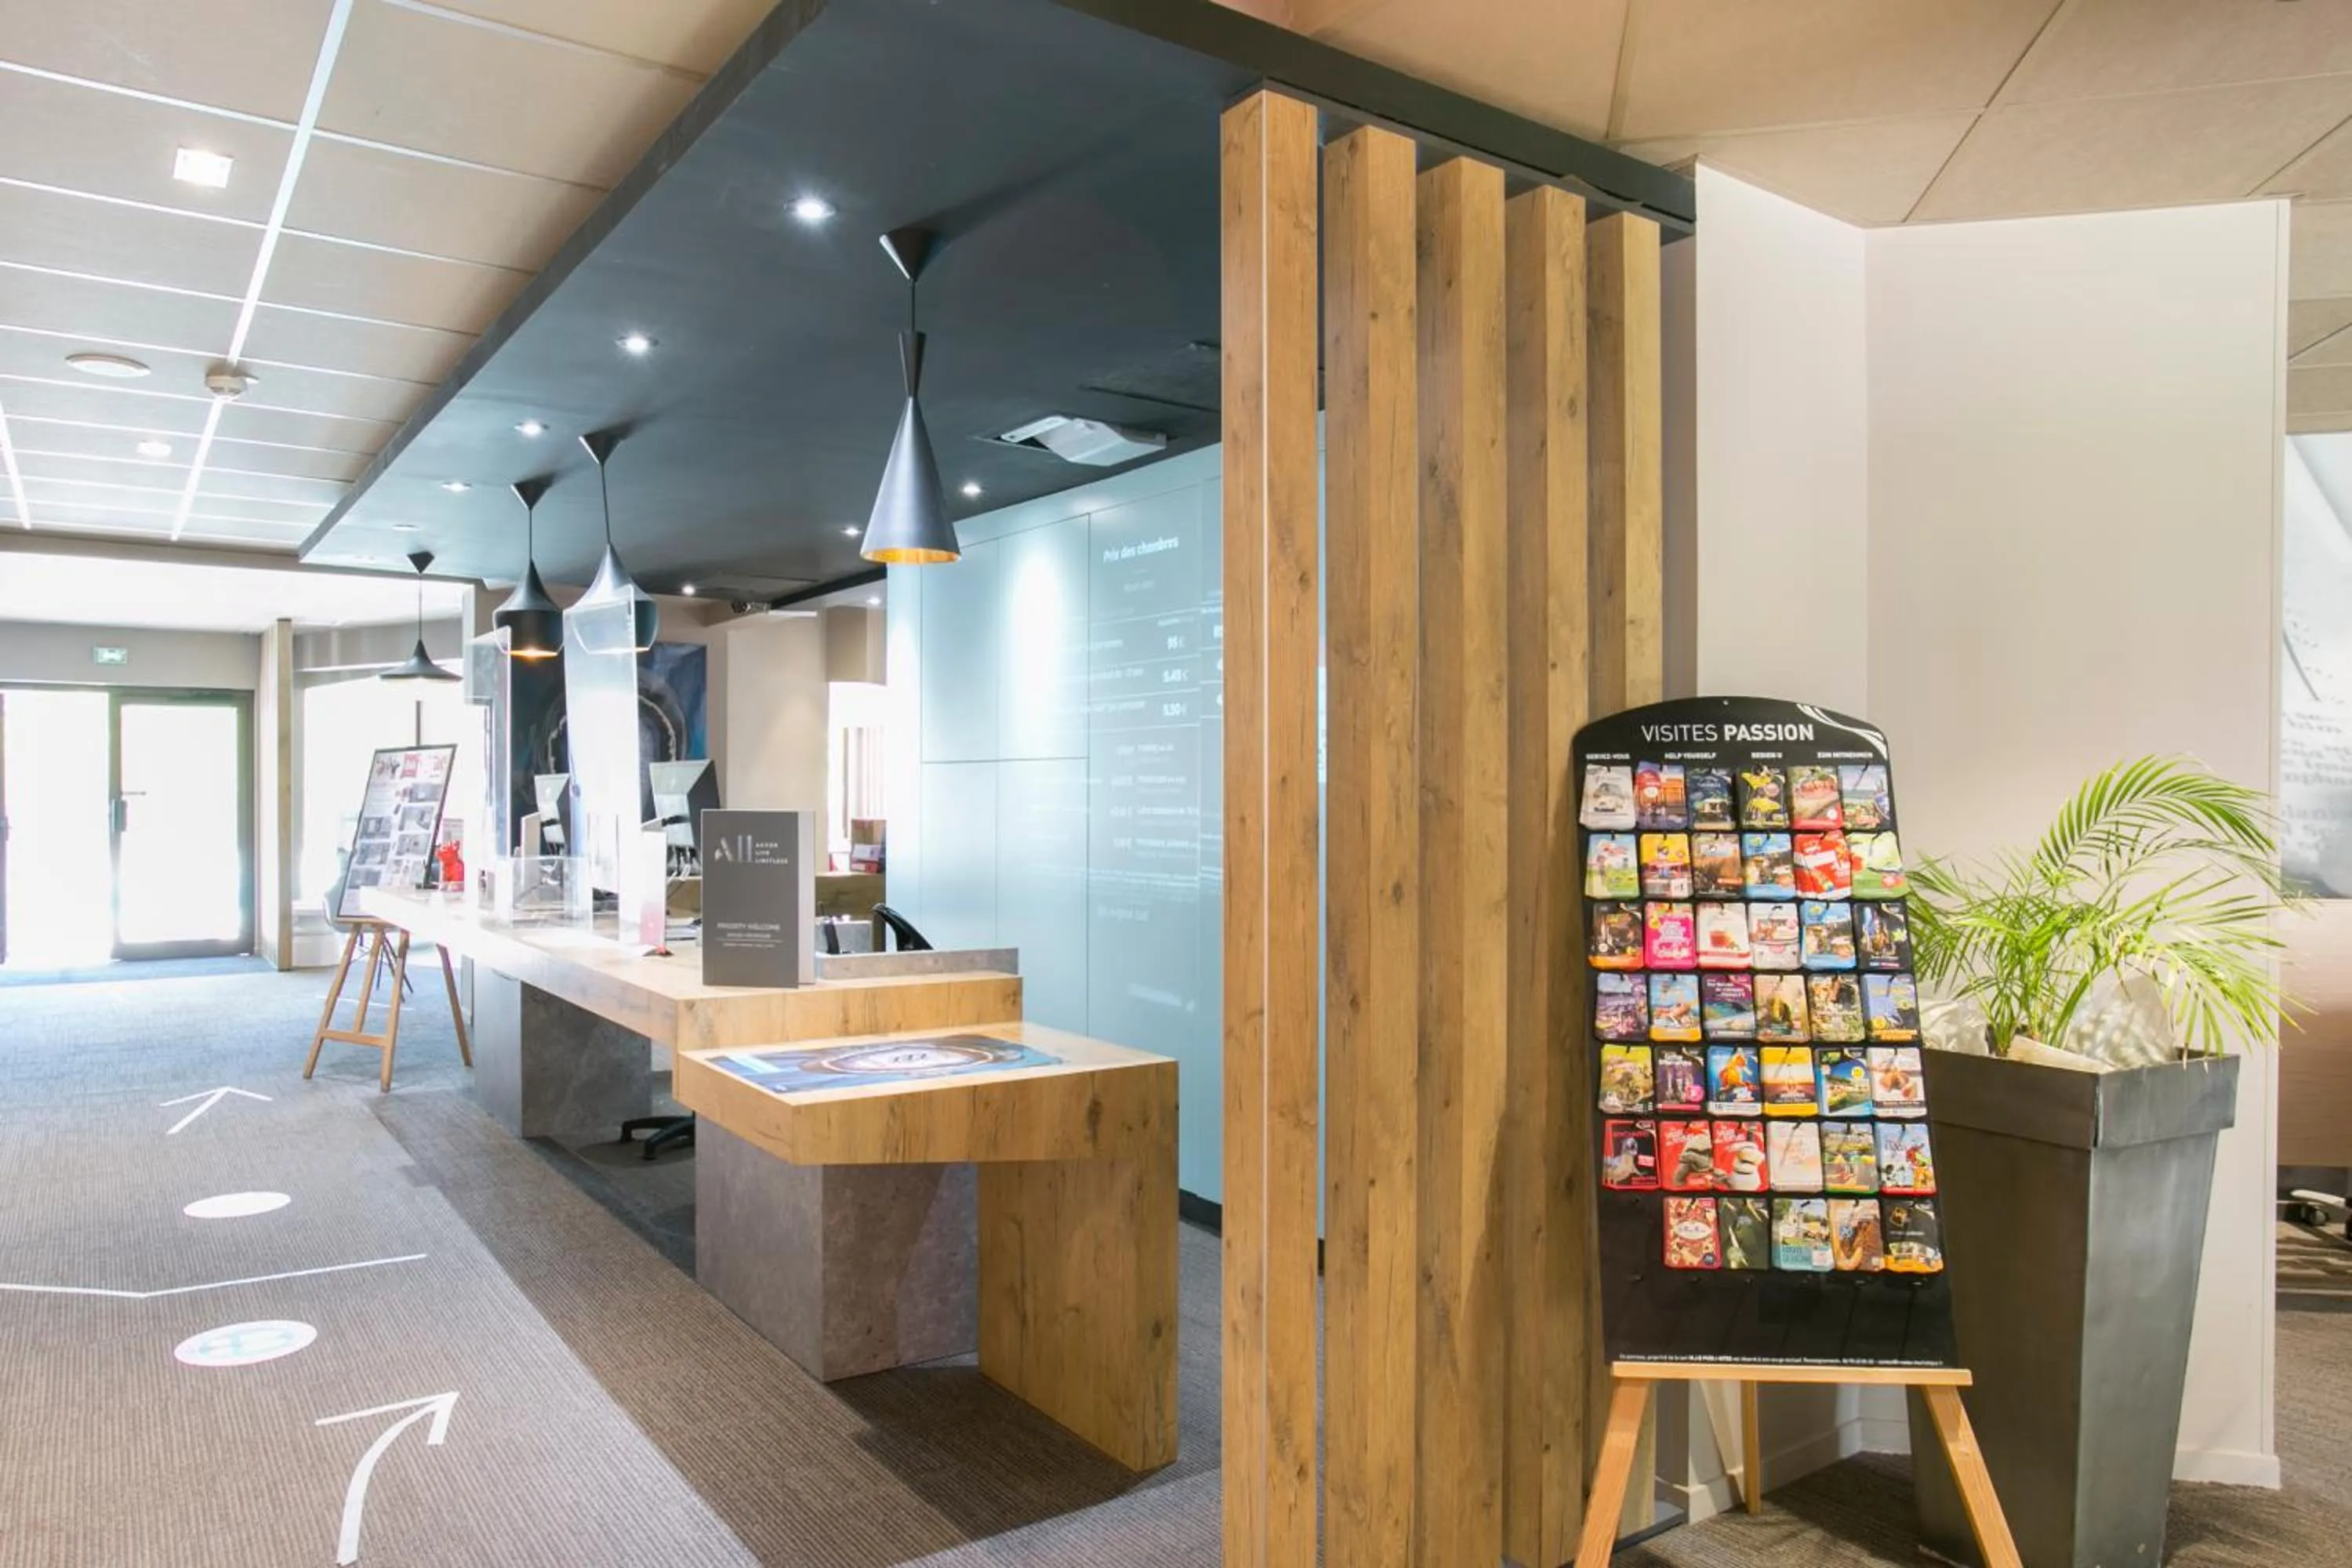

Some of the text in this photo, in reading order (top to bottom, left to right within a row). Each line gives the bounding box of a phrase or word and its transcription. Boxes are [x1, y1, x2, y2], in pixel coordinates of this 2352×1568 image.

[1103, 536, 1179, 564] Prix des chambres
[1641, 723, 1814, 742] VISITES PASSION
[1664, 751, 1682, 760] HELP
